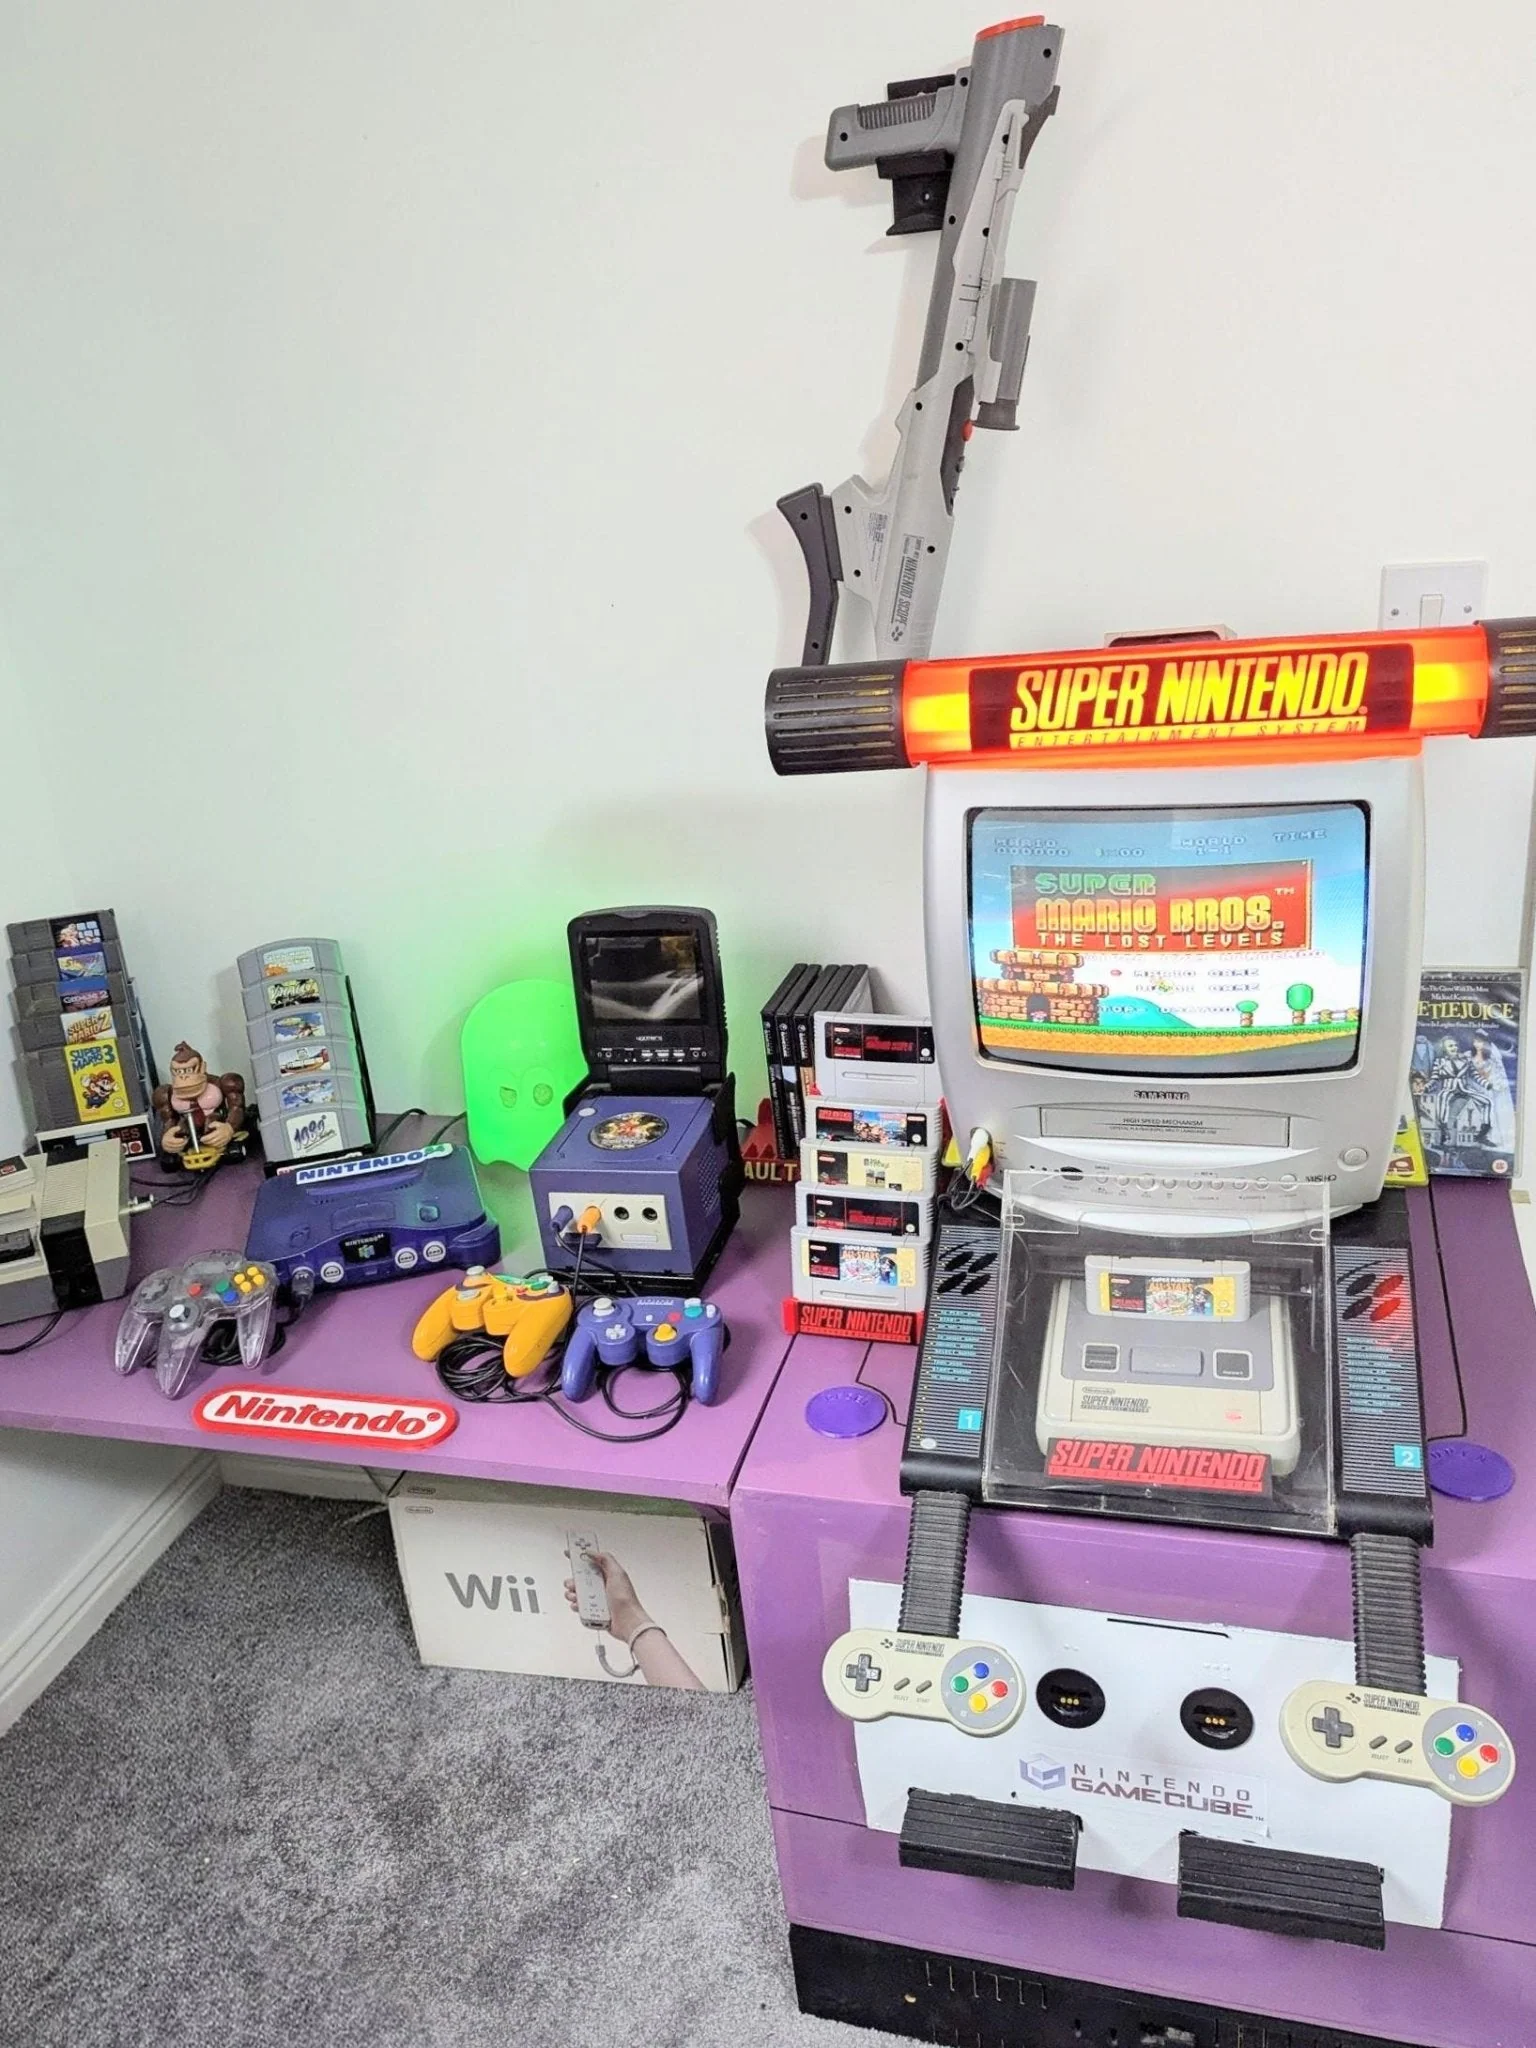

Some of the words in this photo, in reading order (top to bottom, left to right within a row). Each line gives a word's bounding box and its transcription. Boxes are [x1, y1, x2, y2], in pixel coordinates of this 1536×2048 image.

[1010, 664, 1149, 731] SUPER
[1155, 652, 1369, 724] NINTENDO
[1018, 726, 1236, 748] ENTERTAINMENT
[1257, 720, 1362, 737] SYSTEM
[1273, 829, 1327, 842] TIME
[1035, 872, 1157, 896] SUPER
[1035, 897, 1157, 933] MARIO
[1169, 895, 1285, 933] BROS.
[1038, 933, 1083, 947] THE
[1104, 934, 1167, 949] LOST
[1185, 931, 1285, 948] LEVELS
[67, 1015, 99, 1035] SUPER
[100, 1009, 113, 1030] 2
[1416, 1001, 1514, 1020] ETLEJUICE
[103, 1044, 115, 1064] 3
[1134, 1090, 1190, 1100] SAMSUNG
[300, 1151, 423, 1181] NINTENDO
[801, 1305, 843, 1328] SUPER
[846, 1310, 912, 1334] NINTENDO
[1082, 1394, 1108, 1406] SUPER
[1109, 1396, 1149, 1408] NINTENDO
[214, 1395, 427, 1435] Nintendo
[965, 1414, 974, 1429] 1
[1051, 1439, 1136, 1470] SUPER
[1137, 1445, 1267, 1481] NINTENDO
[1402, 1450, 1414, 1467] 2
[444, 1572, 540, 1614] Wii
[1363, 1693, 1386, 1707] SUPER
[1387, 1696, 1420, 1711] NINTENDO
[1073, 1763, 1250, 1801] NINTENDO
[1071, 1777, 1253, 1820] GAMECUBE
